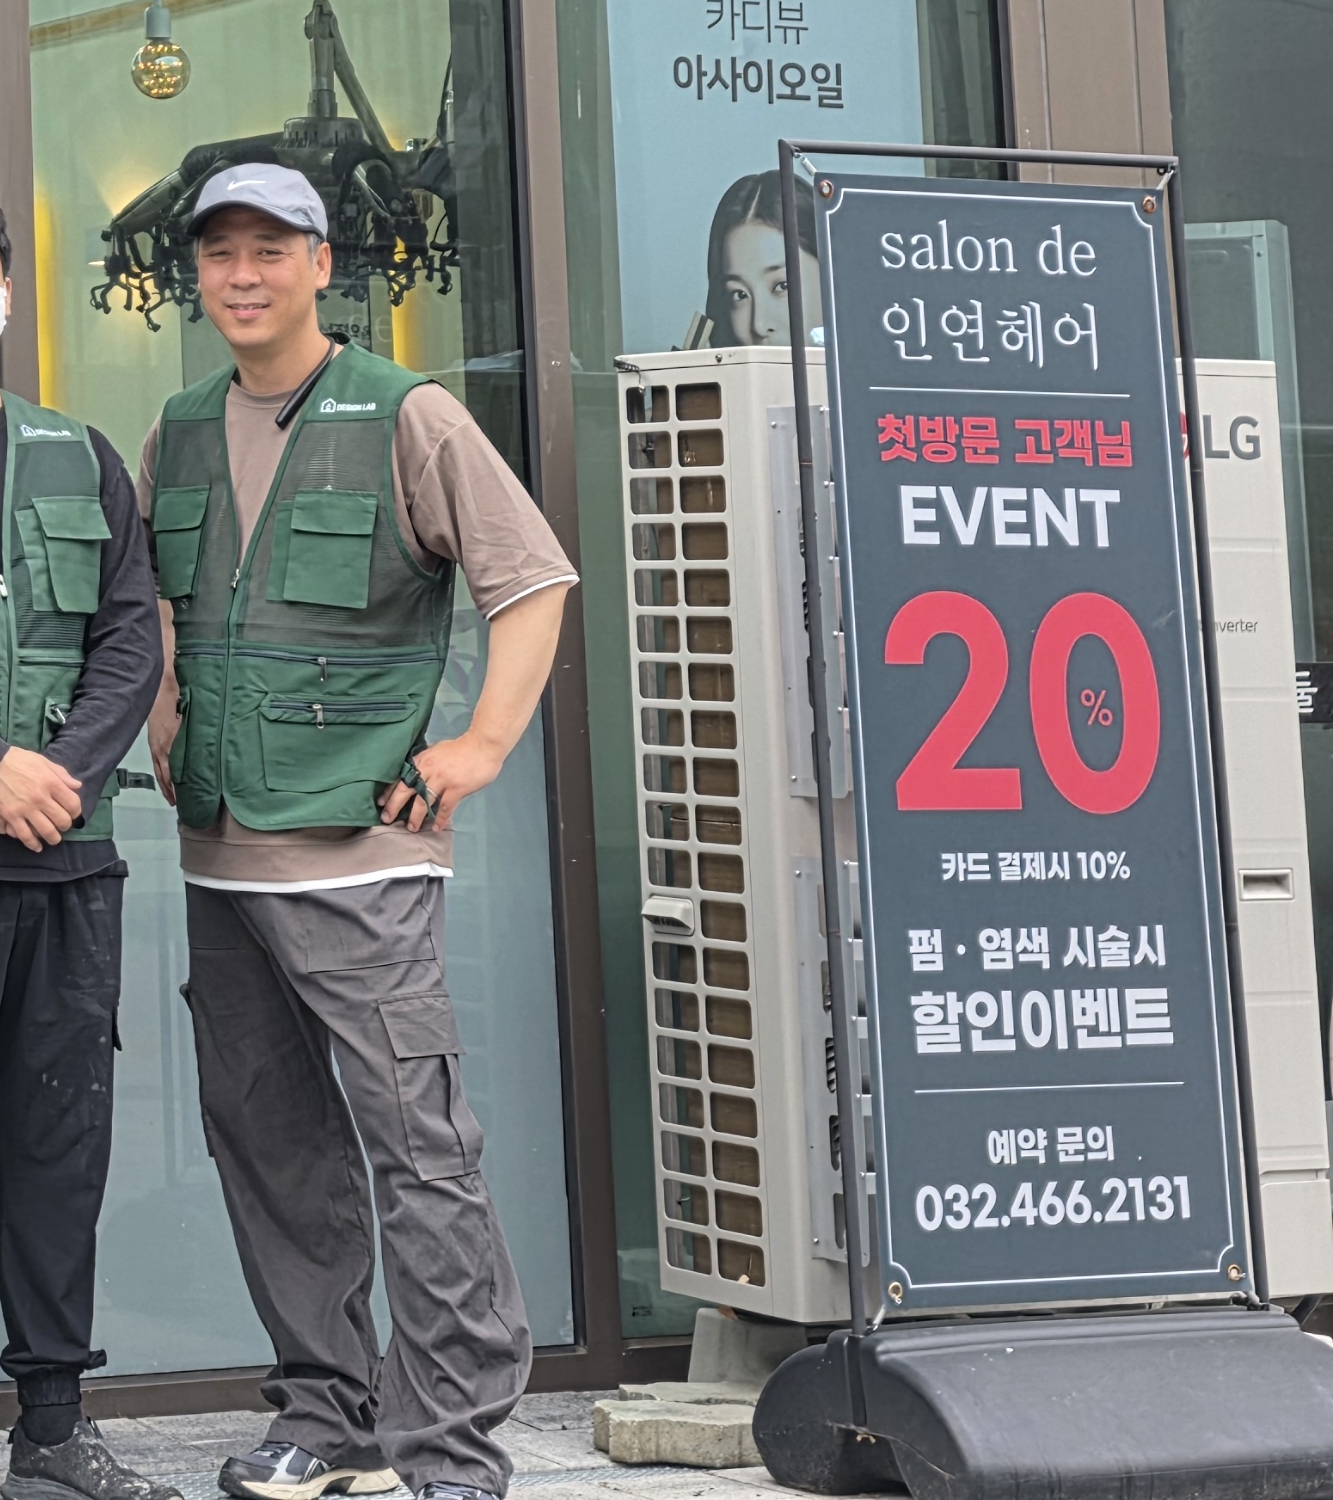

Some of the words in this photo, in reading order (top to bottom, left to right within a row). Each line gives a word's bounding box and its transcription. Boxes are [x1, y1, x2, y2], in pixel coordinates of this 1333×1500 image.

[673, 54, 845, 109] 아사이오일
[880, 219, 1018, 275] salon
[1038, 223, 1098, 277] de
[881, 296, 1099, 371] 인연헤어
[876, 412, 1001, 465] 첫방문
[1014, 417, 1134, 468] 고객님
[1202, 414, 1262, 461] LG
[899, 484, 1121, 547] EVENT
[1213, 619, 1259, 633] nverter
[883, 589, 1161, 815] 20
[940, 851, 991, 882] 카드
[997, 851, 1071, 882] 결제시
[1076, 850, 1131, 881] 10%
[907, 927, 944, 972] 펌
[978, 925, 1051, 969] 염색
[1062, 924, 1167, 969] 시술시
[909, 986, 1175, 1055] 할인이벤트
[986, 1126, 1049, 1165] 예약
[1056, 1125, 1115, 1162] 문의
[915, 1175, 1192, 1231] 032.466.2131
